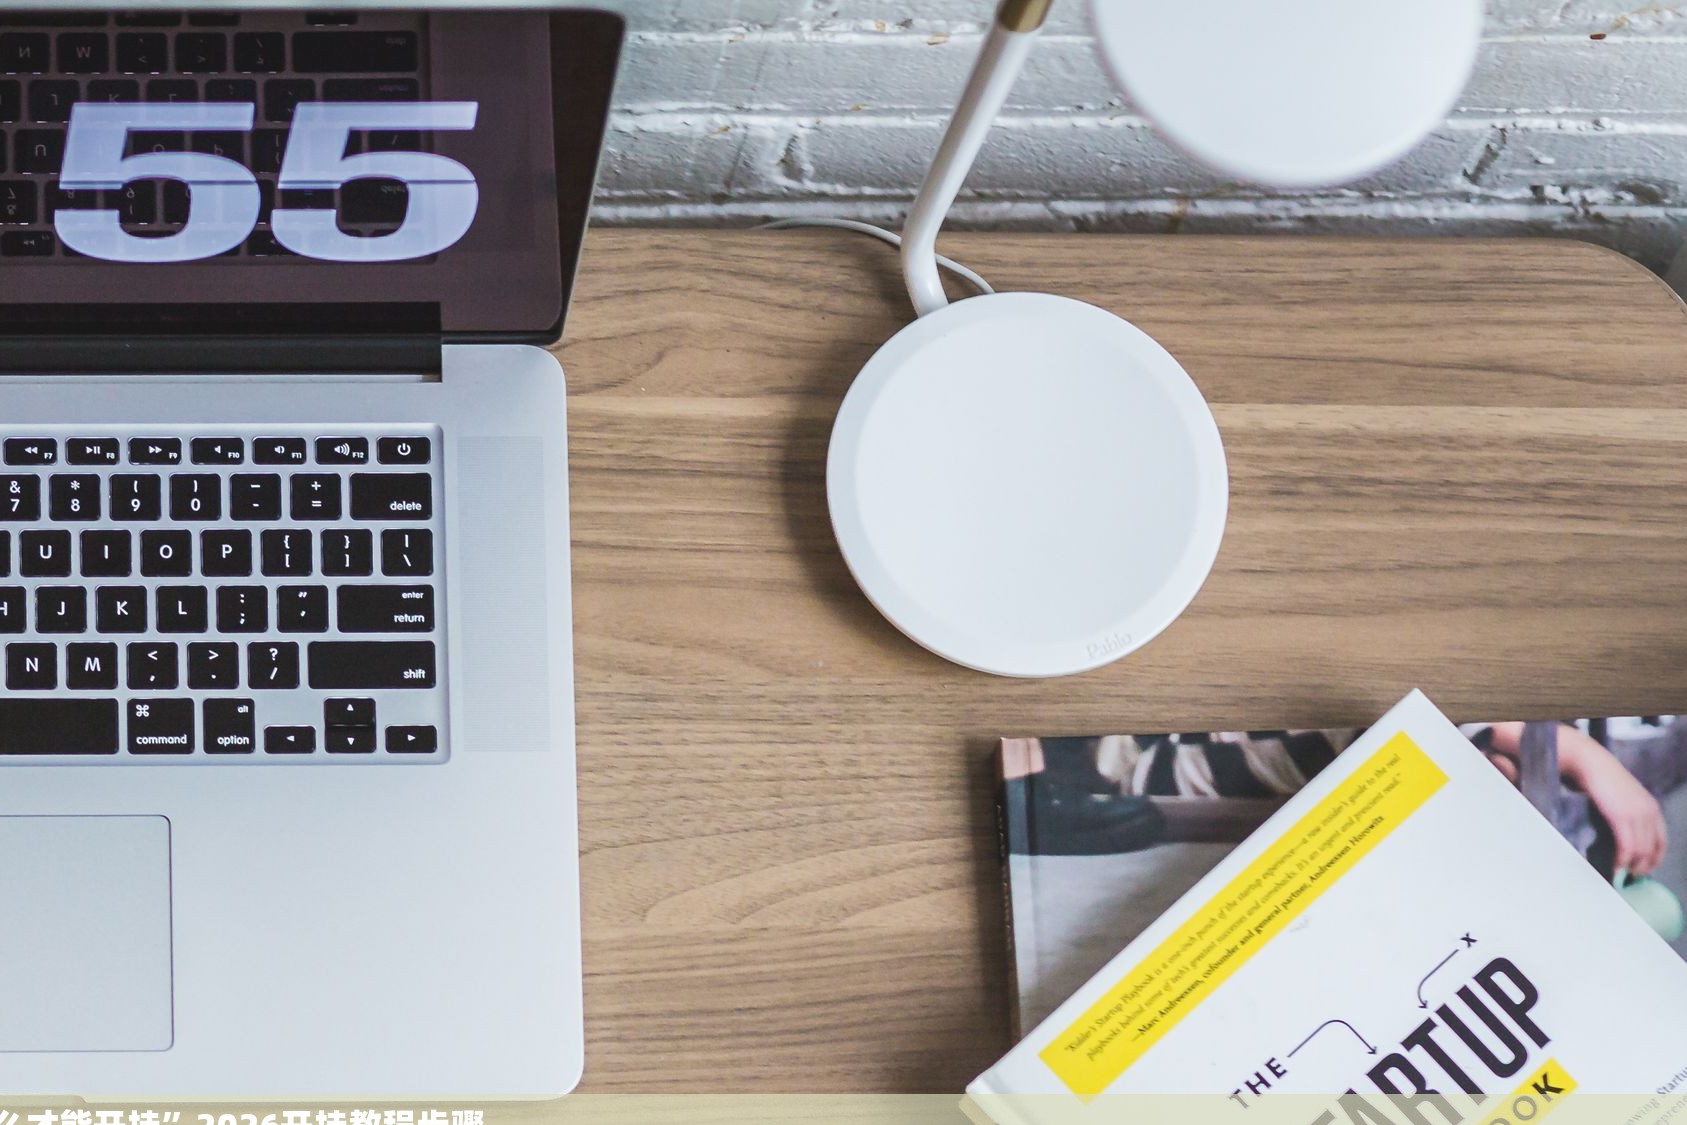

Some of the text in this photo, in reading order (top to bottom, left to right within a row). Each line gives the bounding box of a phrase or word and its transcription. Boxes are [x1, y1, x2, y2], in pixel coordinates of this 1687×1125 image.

[54, 99, 481, 264] 55
[10, 498, 20, 512] 7
[71, 498, 80, 512] 8
[131, 498, 141, 512] 9
[191, 498, 201, 511] 0
[390, 500, 422, 511] delete
[40, 545, 52, 559] U
[104, 545, 108, 559] I
[159, 544, 173, 559] O
[222, 544, 232, 558] P
[57, 601, 65, 615] J
[117, 601, 128, 615] K
[178, 601, 187, 615] L
[394, 613, 425, 623] return
[26, 657, 38, 672] N
[85, 657, 101, 672] M
[403, 669, 426, 679] shift
[237, 705, 249, 713] alt
[136, 734, 187, 744] command
[217, 735, 249, 747] option
[1228, 1057, 1288, 1110] THE
